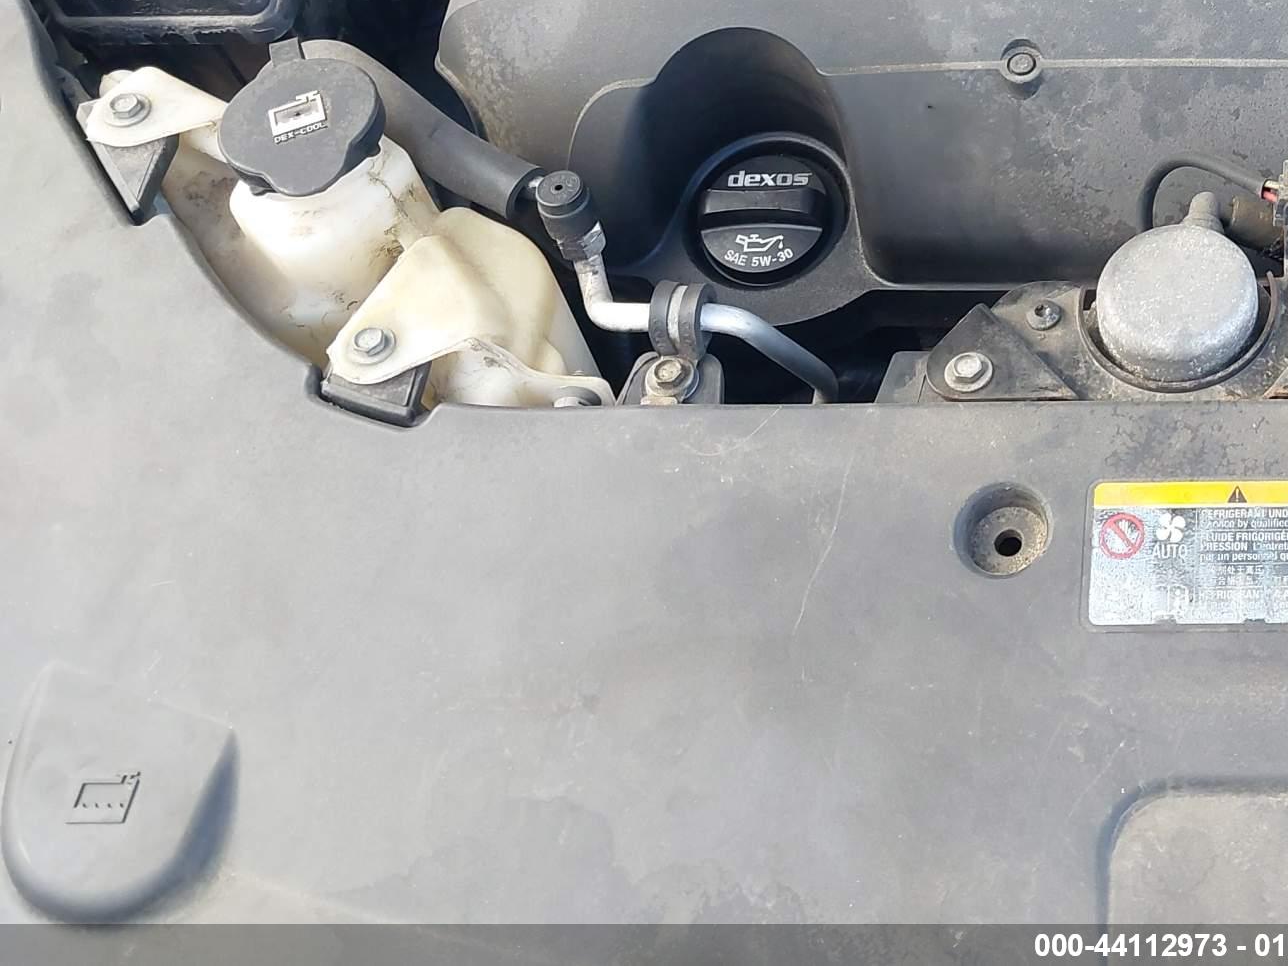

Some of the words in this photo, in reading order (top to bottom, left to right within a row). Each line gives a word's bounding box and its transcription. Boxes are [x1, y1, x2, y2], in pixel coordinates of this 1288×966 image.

[274, 121, 328, 145] DEX-COOL
[728, 170, 812, 187] dexos
[724, 249, 747, 266] SAE
[751, 248, 794, 267] 5W-30
[1237, 519, 1249, 529] by
[1152, 544, 1188, 559] AUTO
